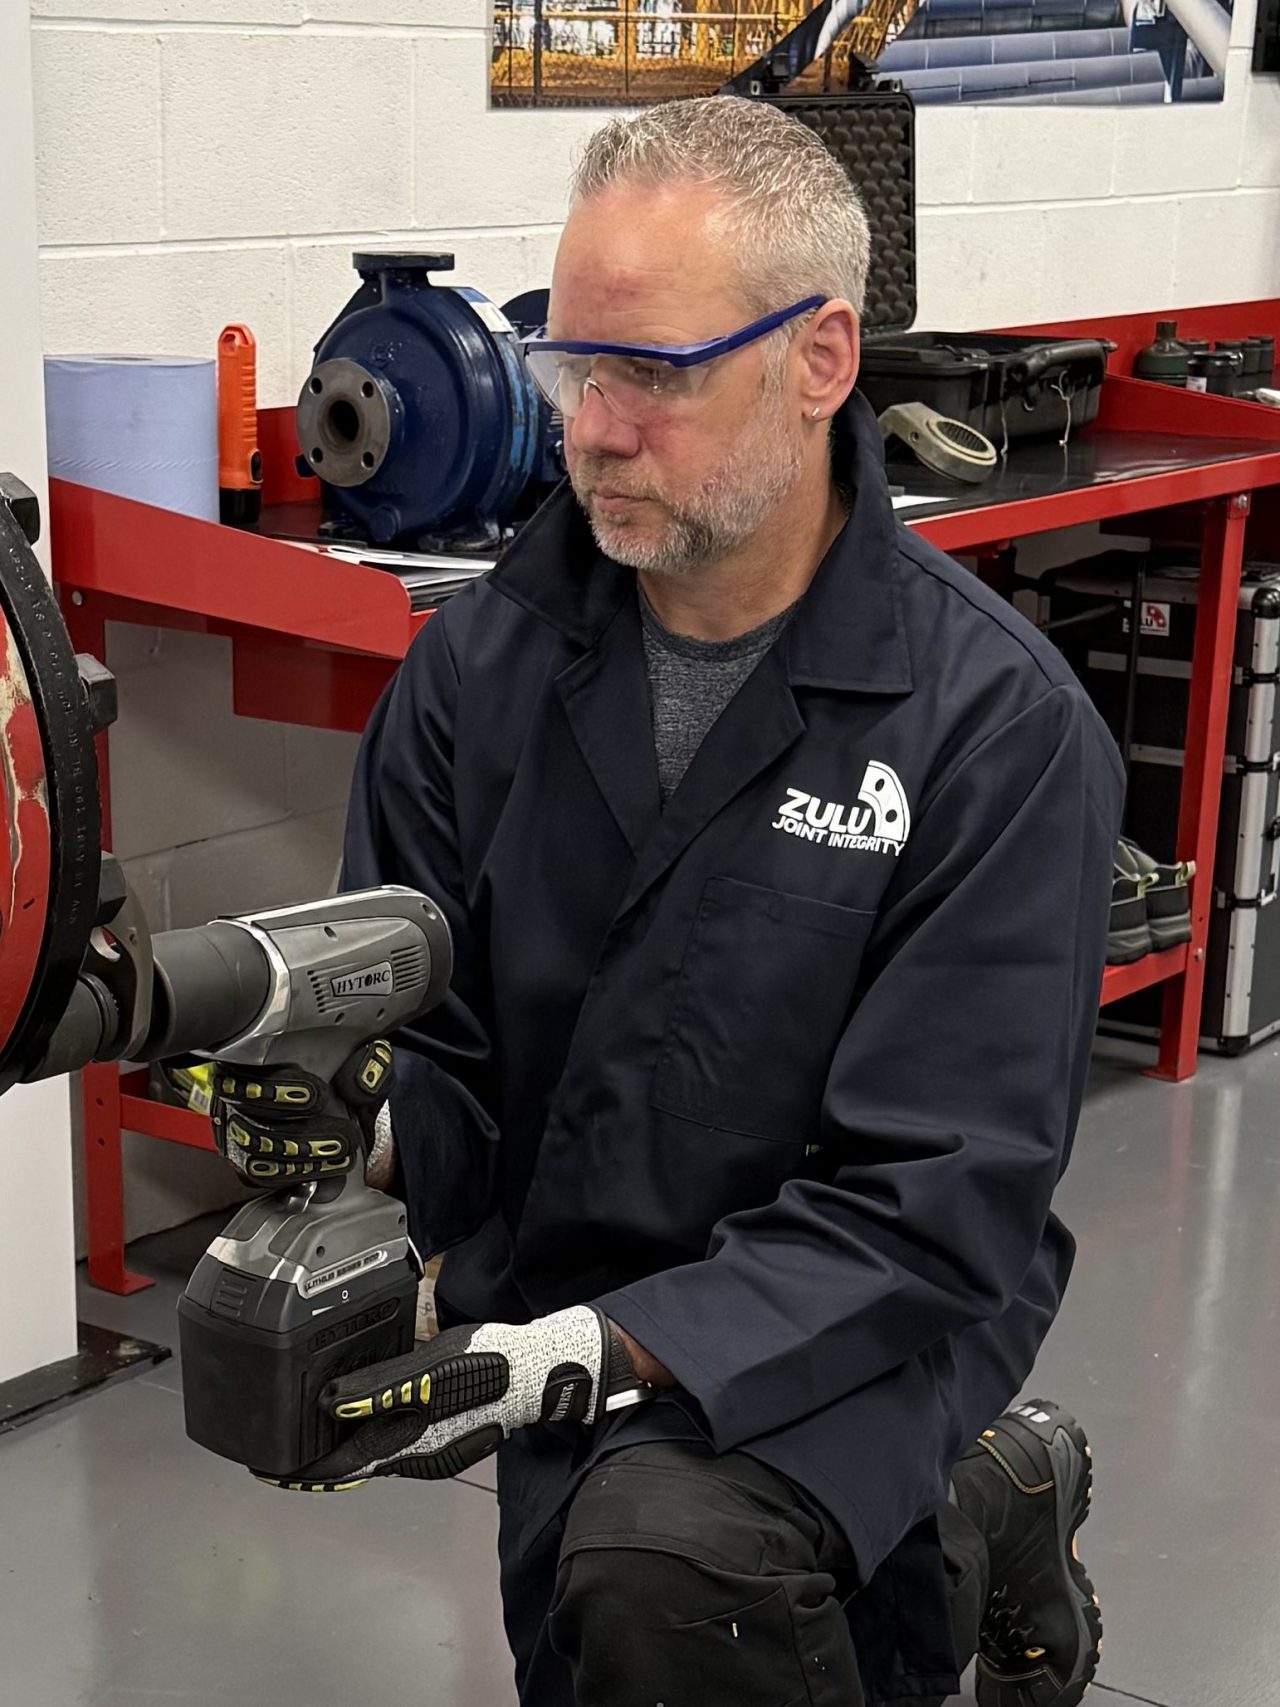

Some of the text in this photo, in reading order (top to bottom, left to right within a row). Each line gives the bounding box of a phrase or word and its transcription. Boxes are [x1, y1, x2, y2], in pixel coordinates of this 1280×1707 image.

[778, 787, 871, 835] ZULU
[772, 815, 905, 857] JOINT INTEGRITY
